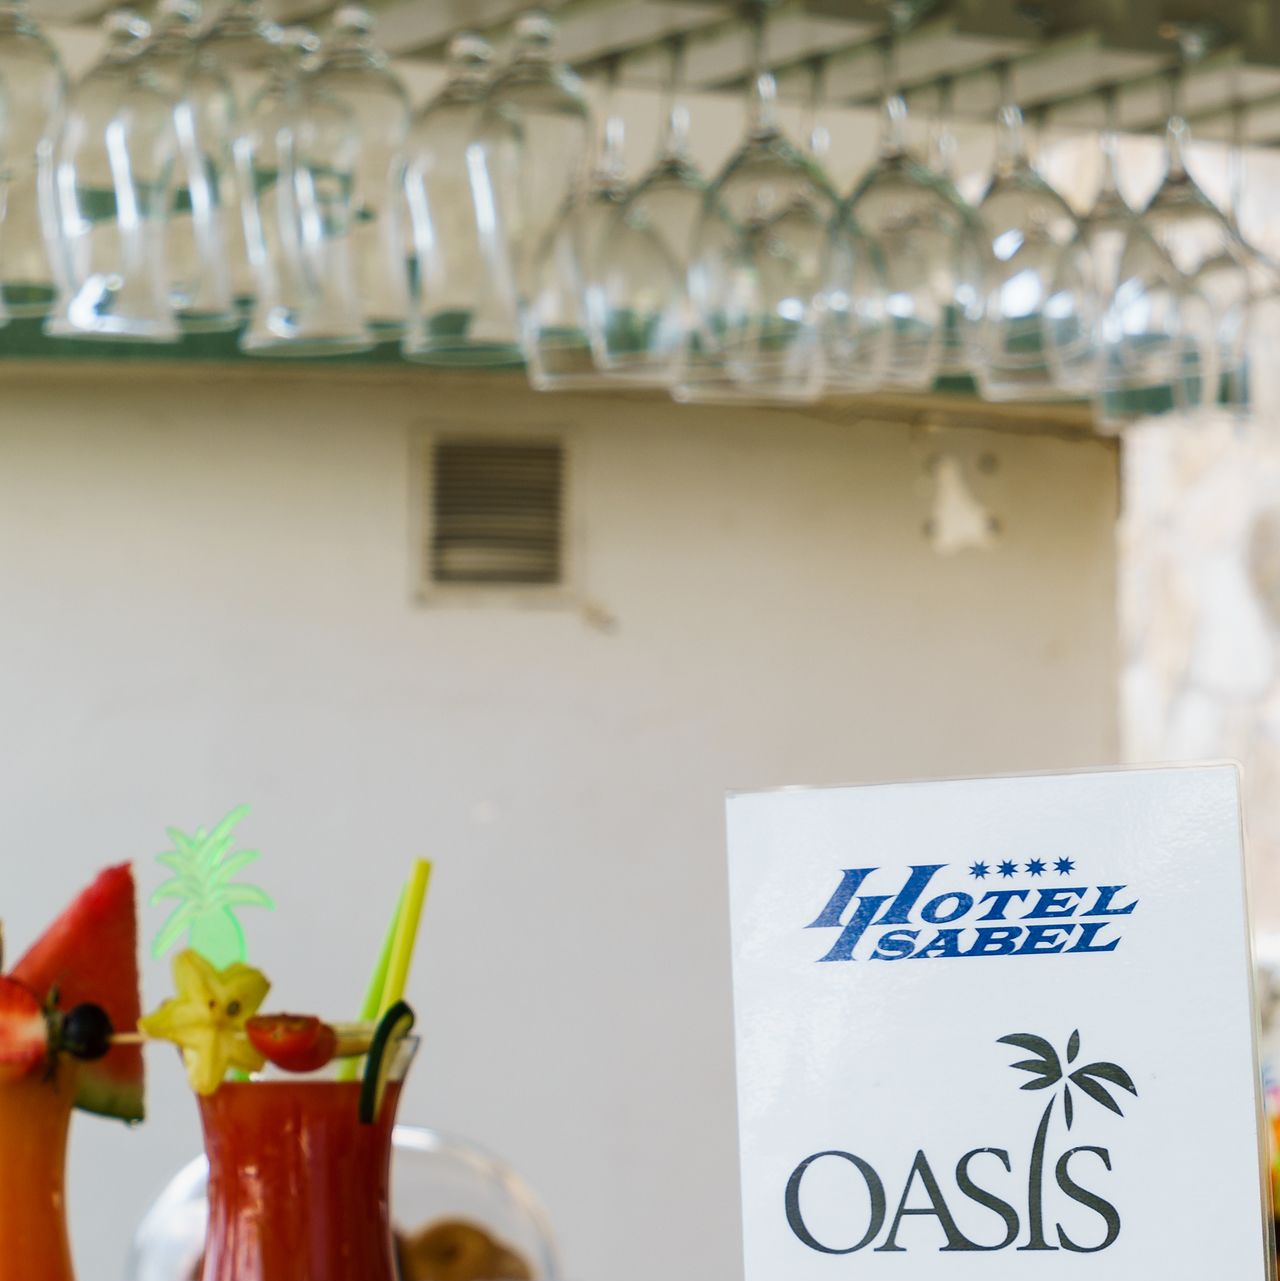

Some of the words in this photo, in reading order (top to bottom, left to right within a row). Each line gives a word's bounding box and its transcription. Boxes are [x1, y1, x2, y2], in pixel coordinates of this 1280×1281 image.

[803, 863, 1140, 929] HOTEL
[815, 894, 1123, 963] ISABEL
[784, 1093, 1122, 1256] OASIS
